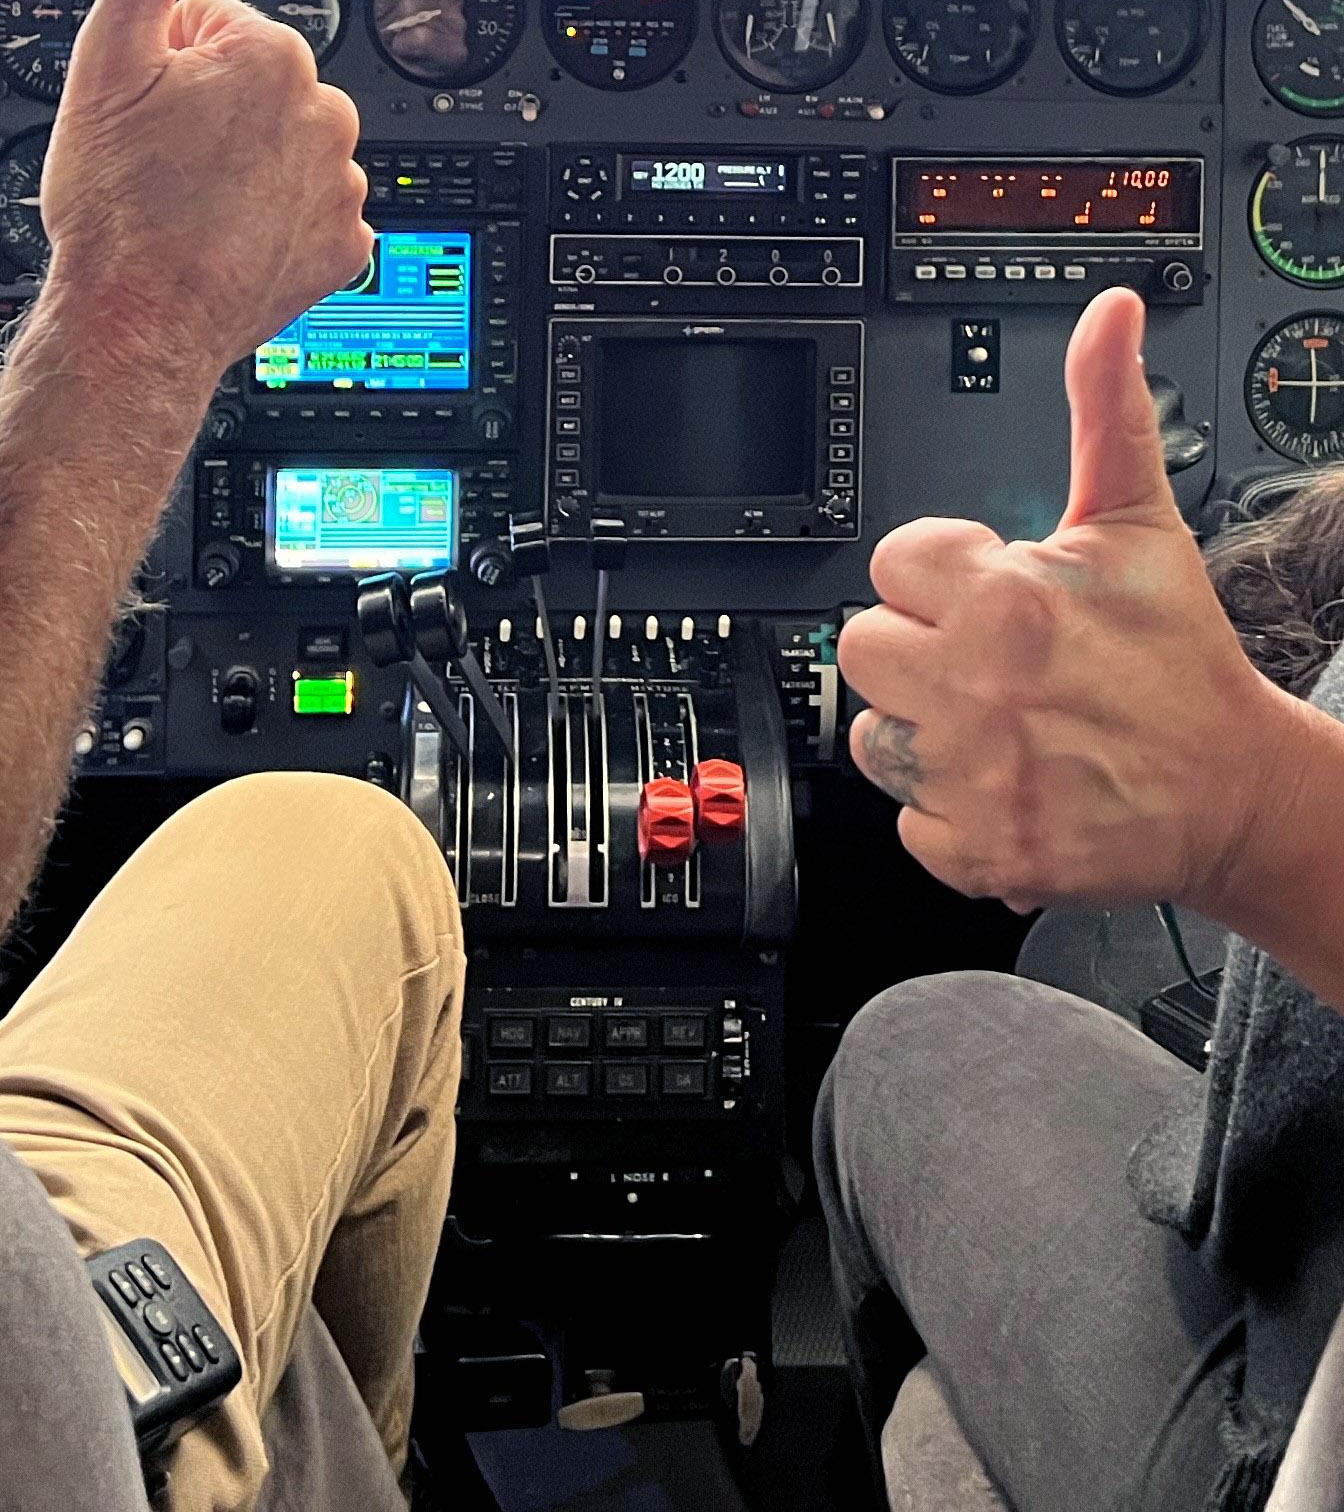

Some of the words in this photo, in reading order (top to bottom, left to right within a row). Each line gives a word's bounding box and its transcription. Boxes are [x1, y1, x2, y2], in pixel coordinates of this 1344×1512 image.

[11, 2, 22, 16] 8
[304, 18, 325, 30] 30
[476, 20, 498, 35] 30
[32, 57, 42, 72] 6
[10, 160, 18, 175] 5
[652, 162, 704, 182] 1200
[718, 166, 755, 174] PRESSURE
[10, 228, 20, 243] 5
[670, 248, 674, 262] 1
[720, 248, 728, 262] 2
[772, 250, 780, 263] 0
[824, 249, 832, 264] 0
[630, 684, 689, 693] MIXTURE
[570, 997, 608, 1007] CENTURY
[724, 1000, 736, 1009] ON
[558, 1026, 582, 1040] NAV
[611, 1026, 642, 1040] APPR
[672, 1026, 697, 1038] REV
[498, 1073, 522, 1086] ATT
[556, 1073, 580, 1087] ALT
[624, 1172, 655, 1182] NOSE
